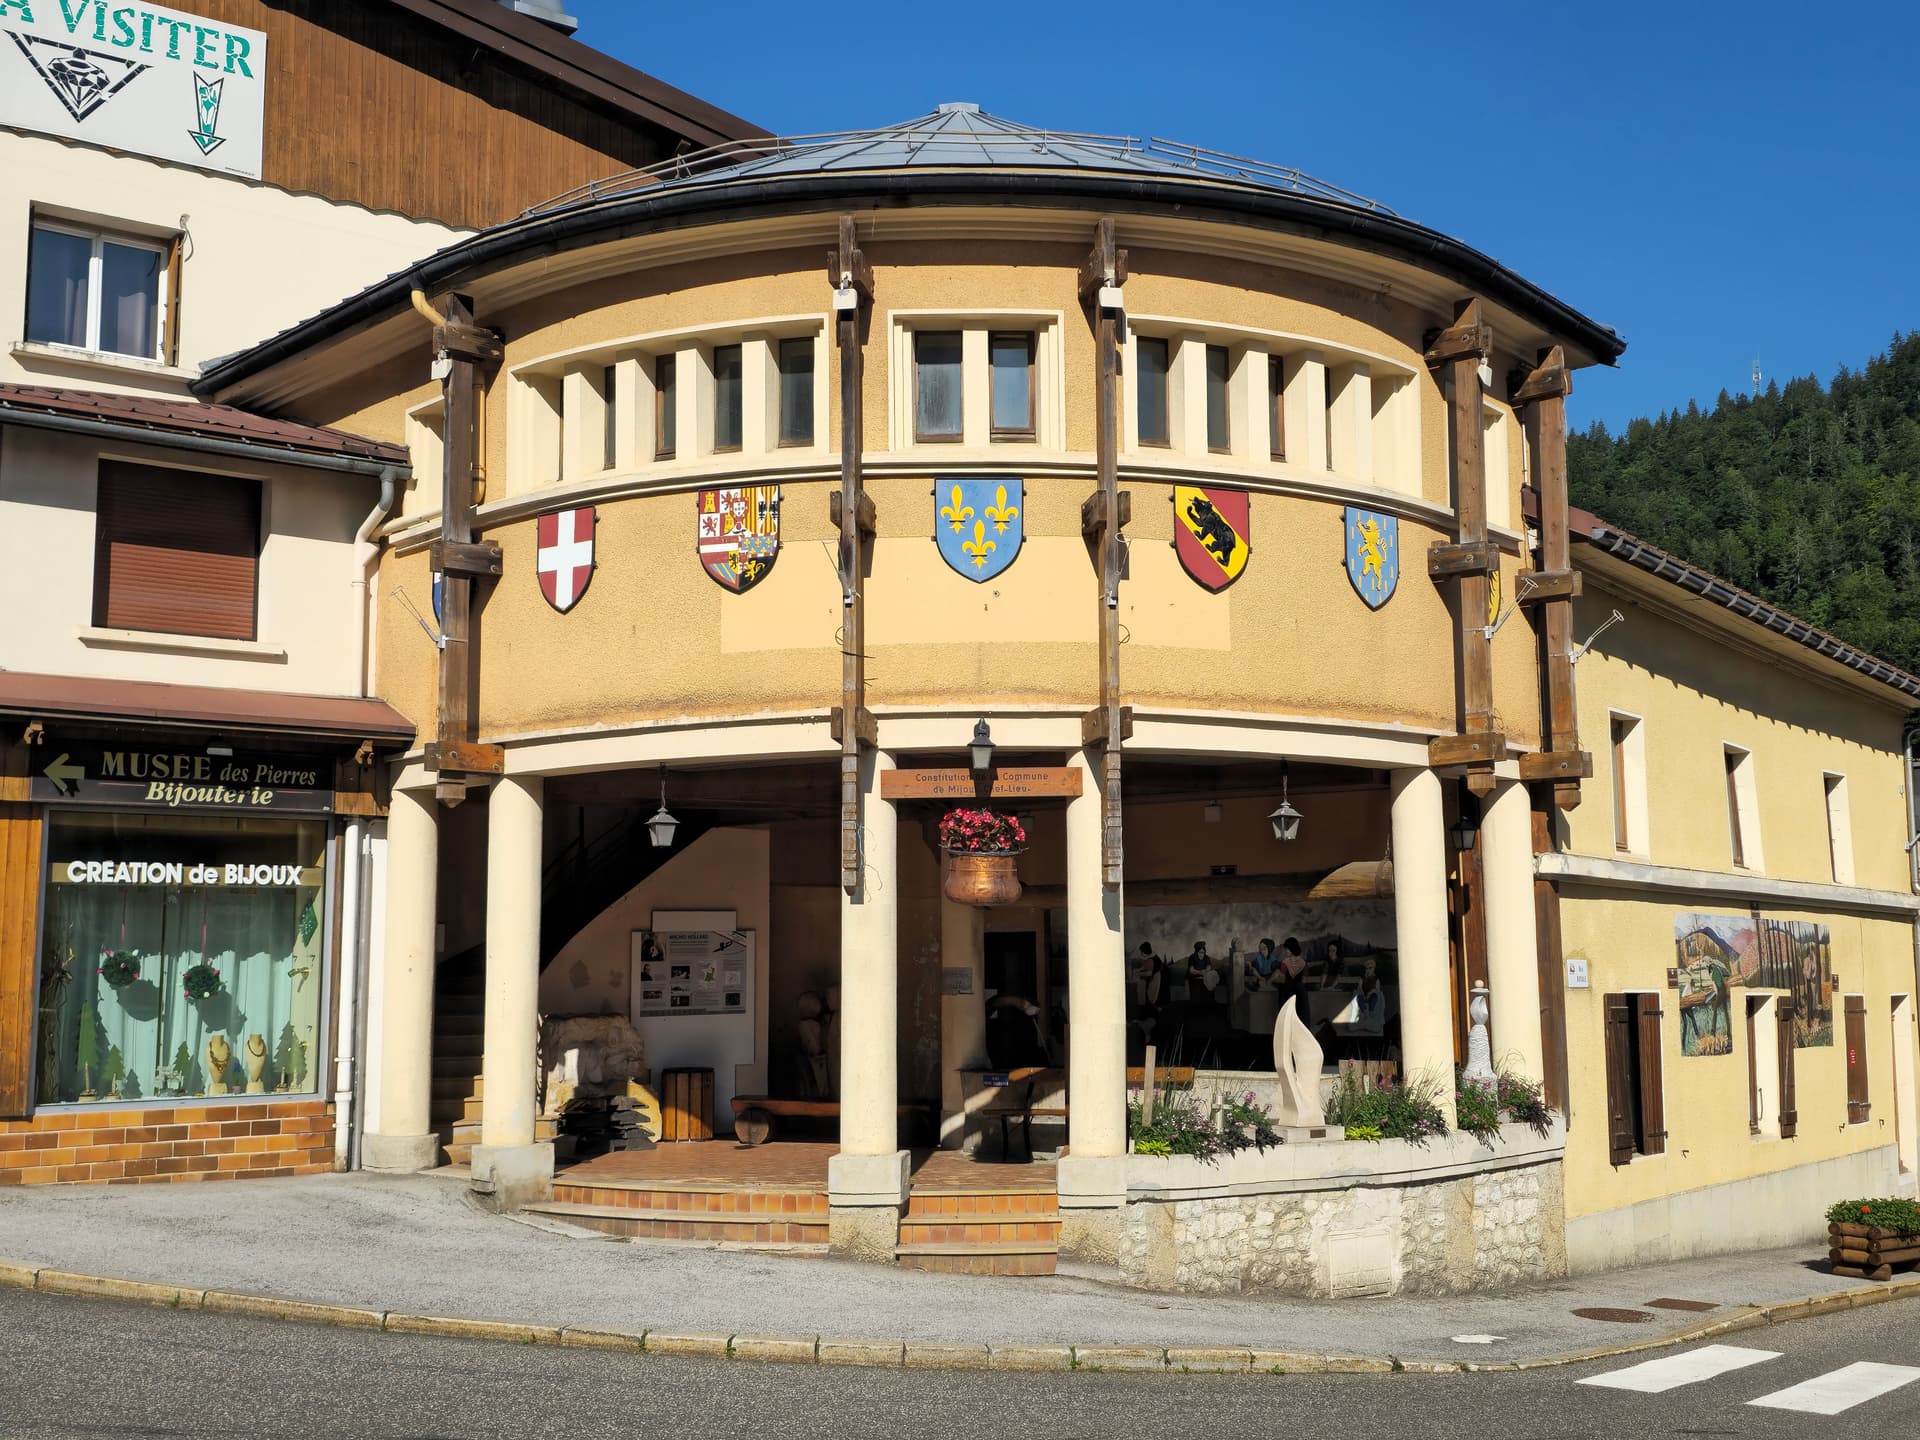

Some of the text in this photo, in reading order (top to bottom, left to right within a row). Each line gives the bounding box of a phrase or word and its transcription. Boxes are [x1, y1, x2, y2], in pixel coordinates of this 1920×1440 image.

[59, 0, 254, 79] VISITER
[220, 763, 249, 782] des
[254, 764, 317, 786] Pierres
[1003, 772, 1048, 781] Commune
[145, 781, 273, 807] Bijouterie
[933, 785, 944, 794] de
[189, 863, 218, 884] de
[225, 863, 302, 885] BIJOUX
